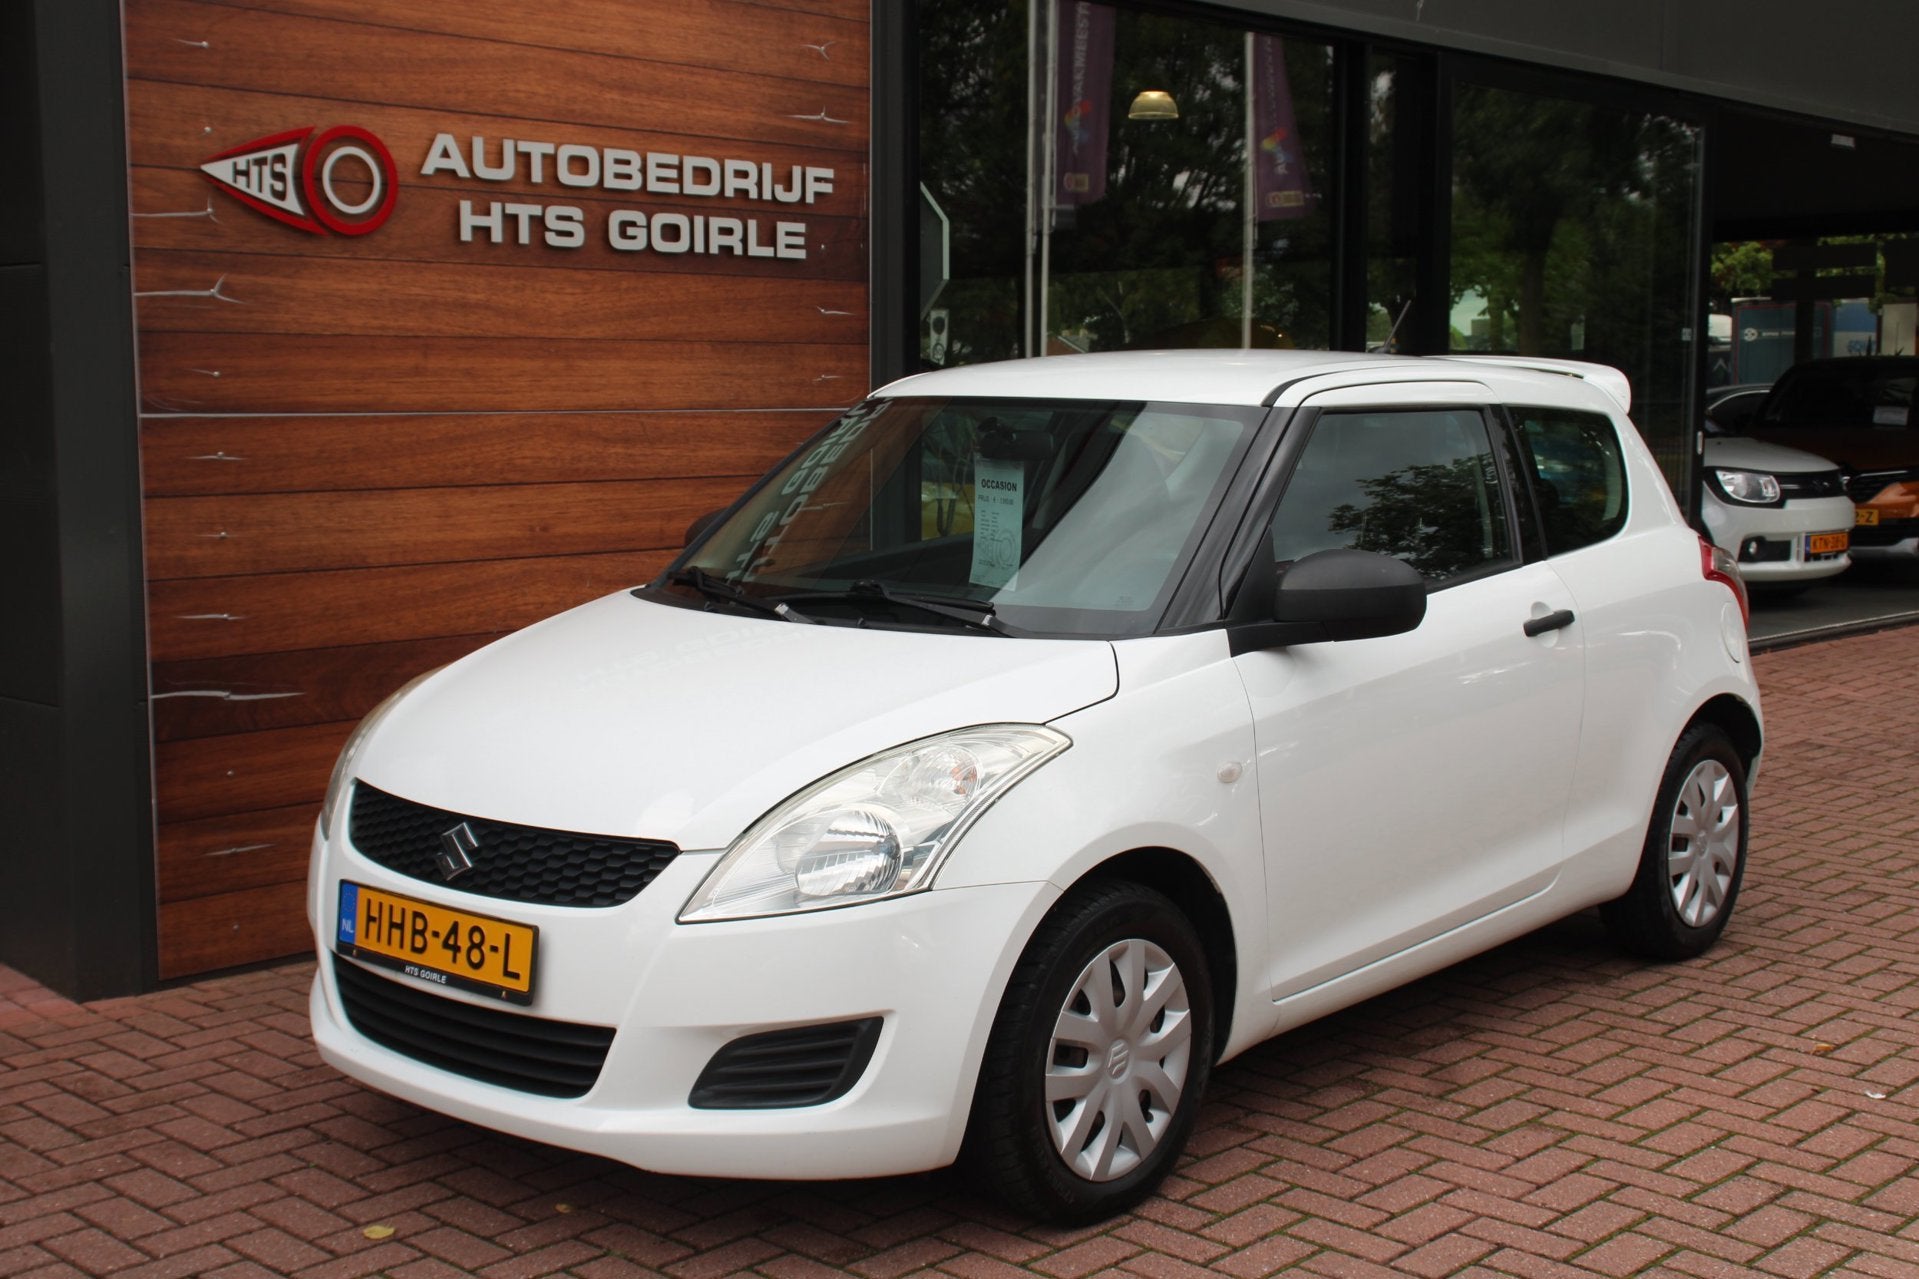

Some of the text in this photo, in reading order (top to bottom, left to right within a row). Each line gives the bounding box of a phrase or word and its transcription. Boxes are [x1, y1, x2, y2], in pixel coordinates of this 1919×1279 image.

[232, 153, 287, 202] HTS
[420, 133, 835, 204] AUTOBEDRIJF
[460, 200, 807, 259] HTS GOIRLE
[981, 478, 1018, 492] OCCASION
[341, 917, 355, 934] NL
[364, 897, 521, 981] HHB-48-L
[404, 965, 448, 985] HTS GOIRLE
